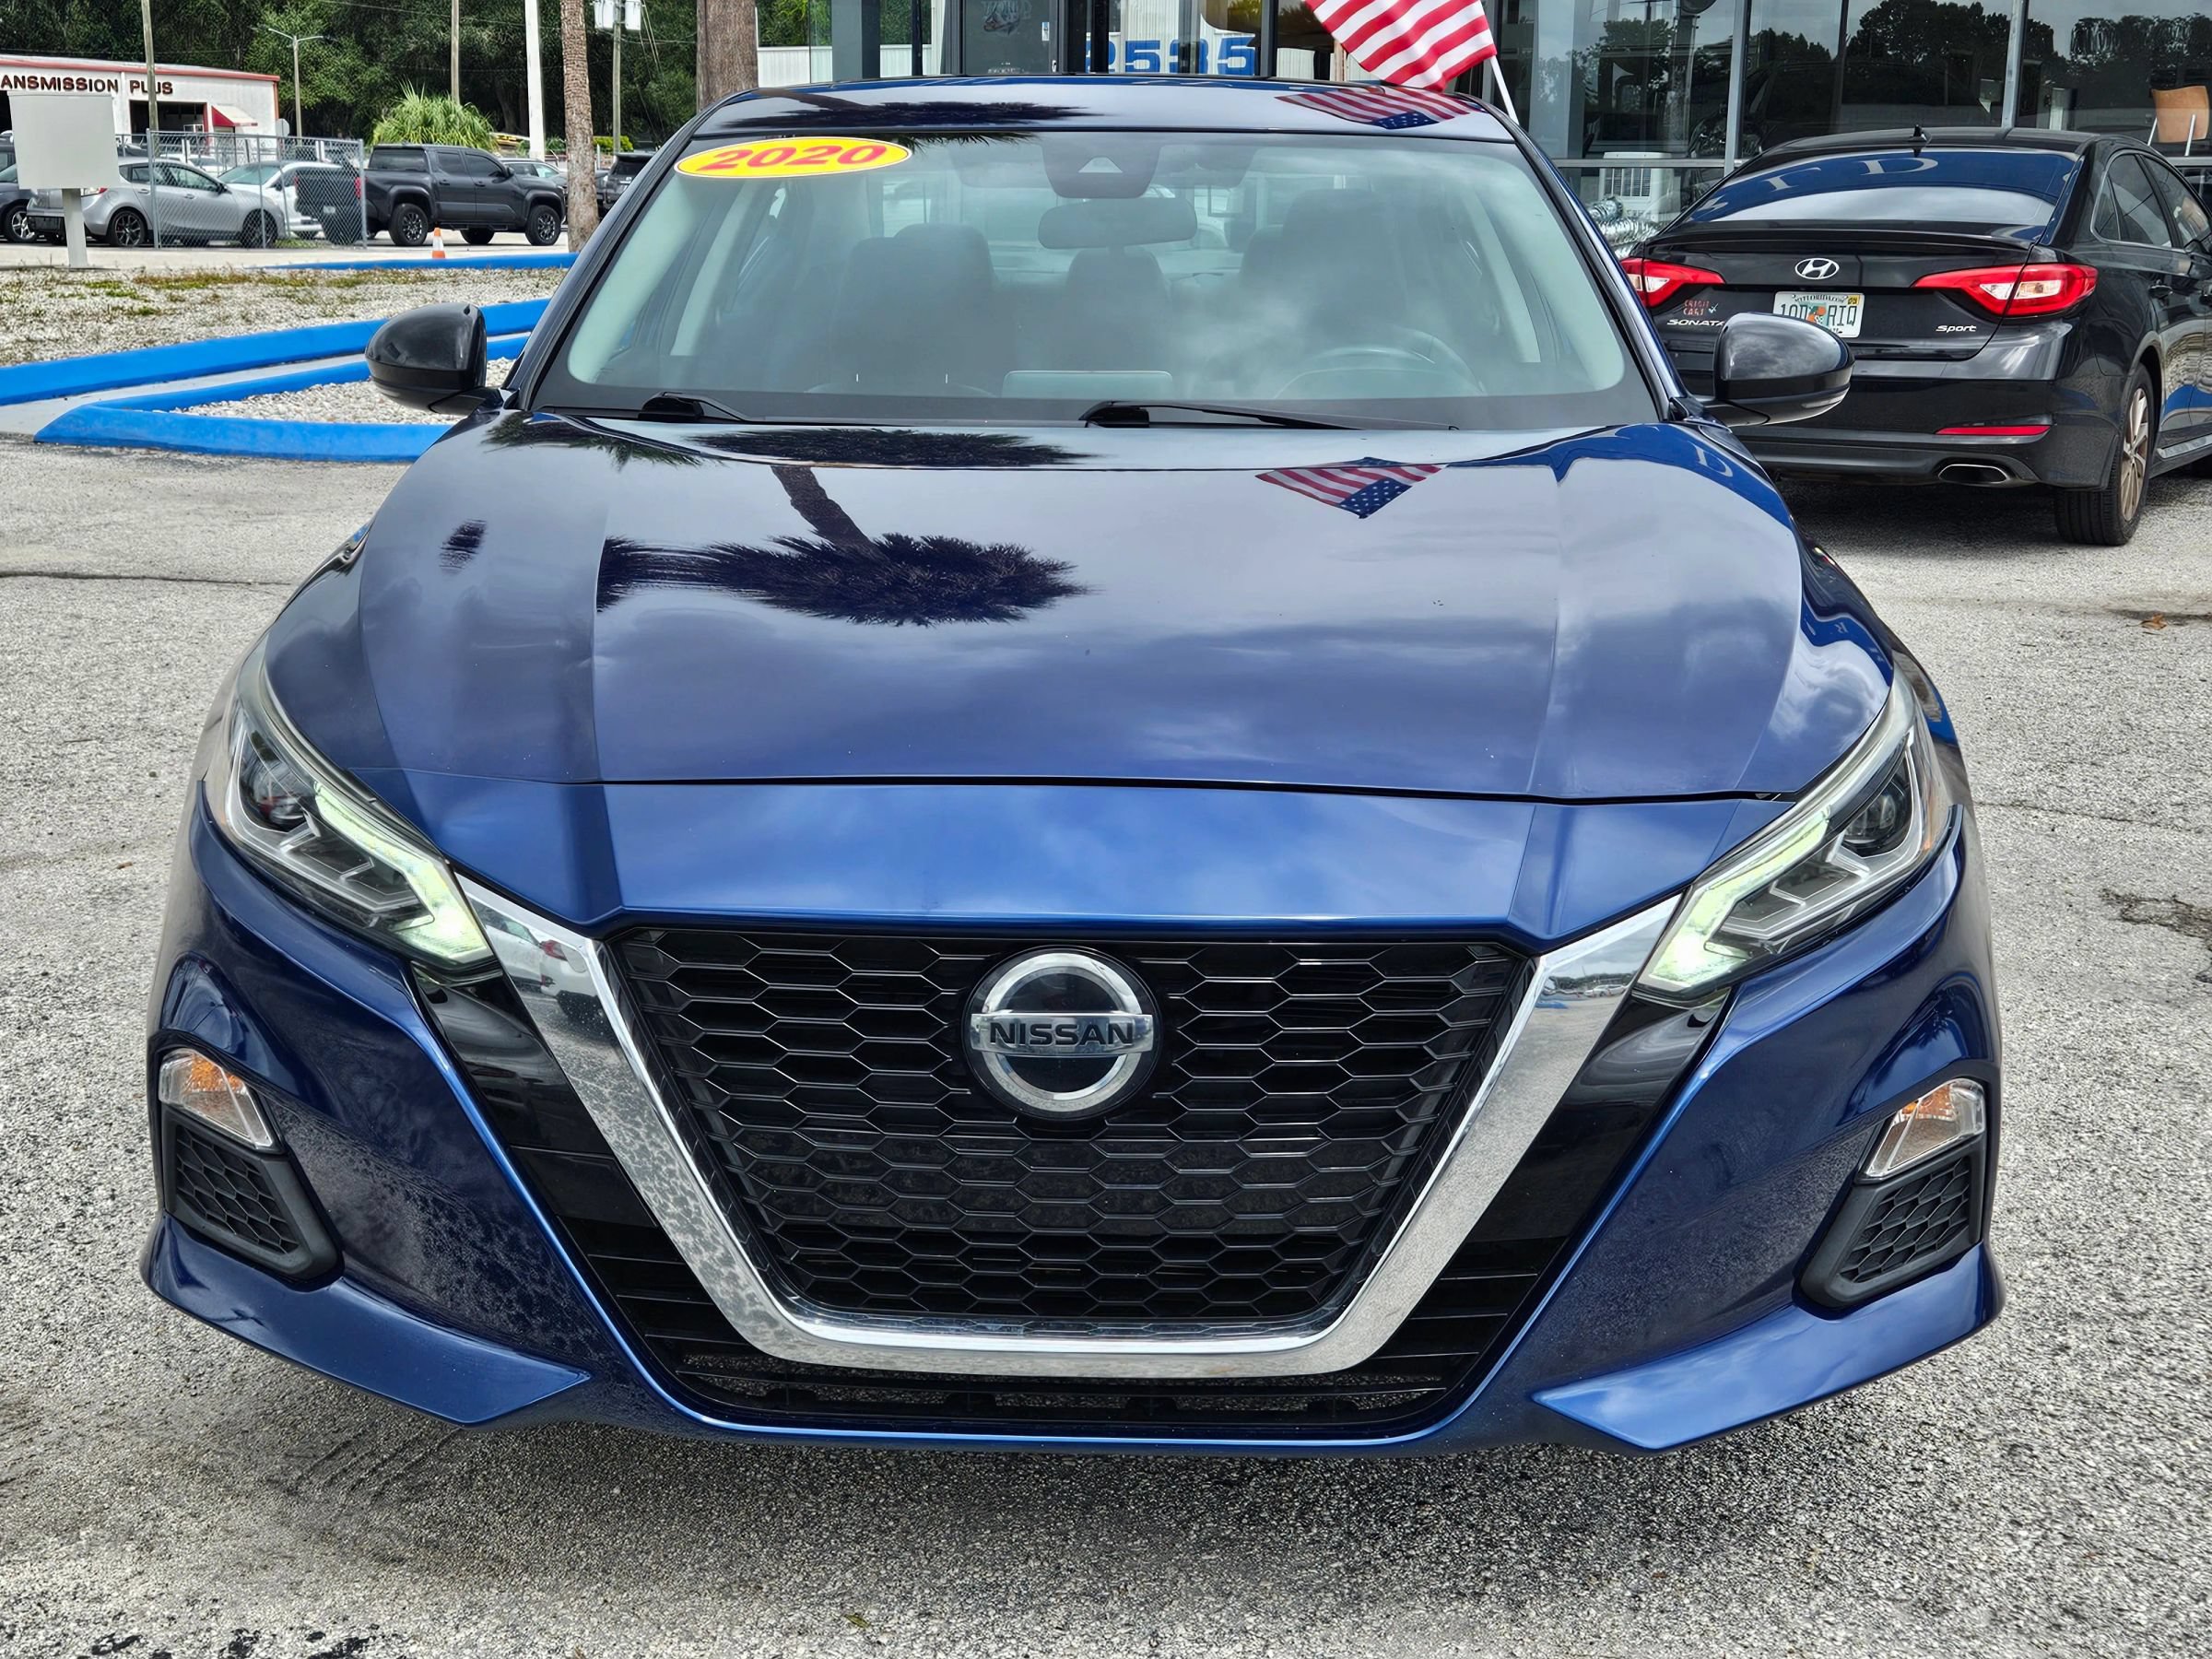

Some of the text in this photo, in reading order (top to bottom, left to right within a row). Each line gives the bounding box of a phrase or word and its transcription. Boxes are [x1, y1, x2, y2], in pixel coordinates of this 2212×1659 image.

[0, 75, 119, 92] ANSMISSION
[696, 145, 887, 171] 2020
[1827, 305, 1857, 326] RIQ
[1936, 324, 1977, 333] Sport
[990, 1022, 1134, 1045] NISSAN
